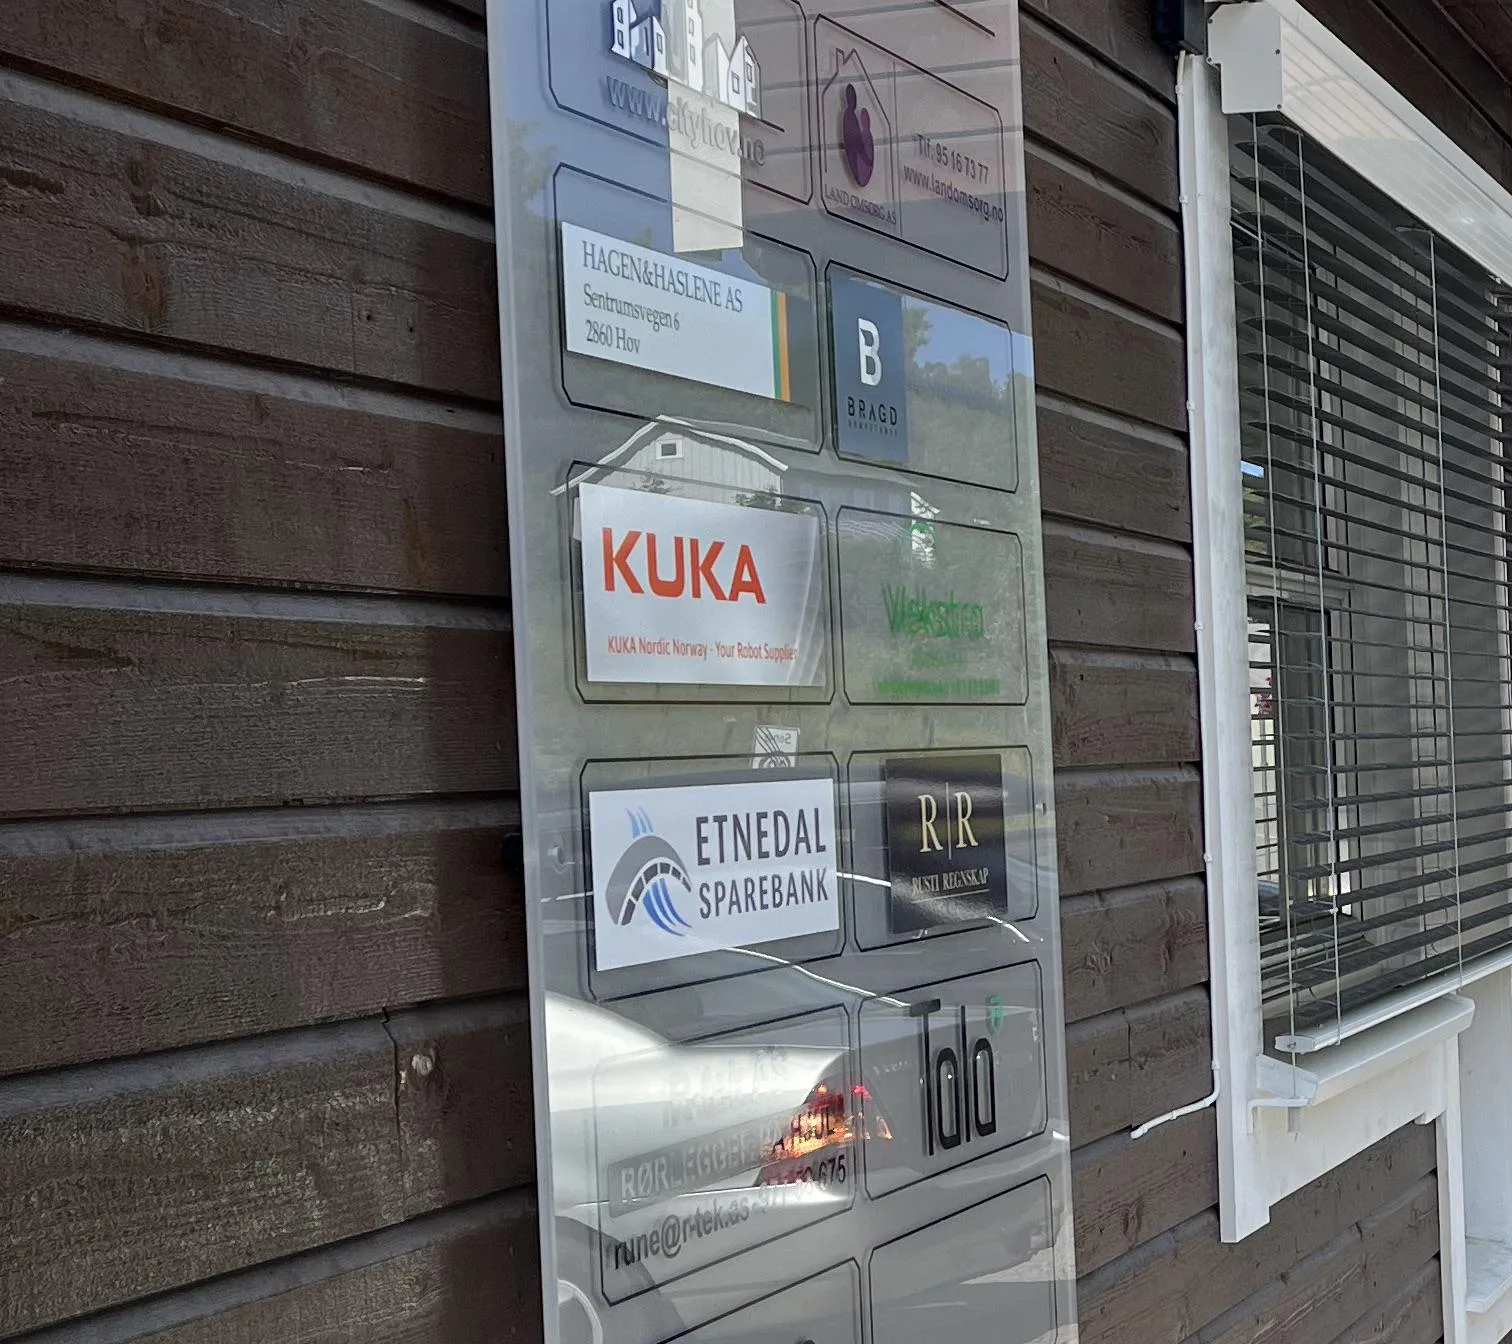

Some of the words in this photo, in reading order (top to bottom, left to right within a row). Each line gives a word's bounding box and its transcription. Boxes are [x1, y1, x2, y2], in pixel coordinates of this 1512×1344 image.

[935, 142, 949, 166] 95
[950, 149, 963, 173] 16
[964, 155, 977, 180] 73
[977, 161, 989, 185] 77
[903, 164, 1004, 223] www.landomsorg.no
[581, 240, 722, 308] HAGEN&HASLENE
[725, 286, 744, 314] AS
[583, 283, 673, 333] Sentrumsvegen
[673, 312, 681, 332] 6
[585, 319, 614, 349] 2860
[615, 327, 641, 354] Hov
[857, 317, 883, 387] B
[847, 396, 899, 427] BRAGD
[602, 527, 767, 605] KUKA
[607, 635, 638, 654] KUKA
[638, 637, 671, 657] Nordic
[672, 639, 708, 661] Norway
[715, 642, 736, 659] Your
[736, 643, 763, 661] Robot
[695, 806, 827, 866] ETNEDAL
[699, 867, 829, 920] SPAREBANK
[911, 872, 940, 896] RUSTI
[942, 867, 989, 891] REGNSKAP
